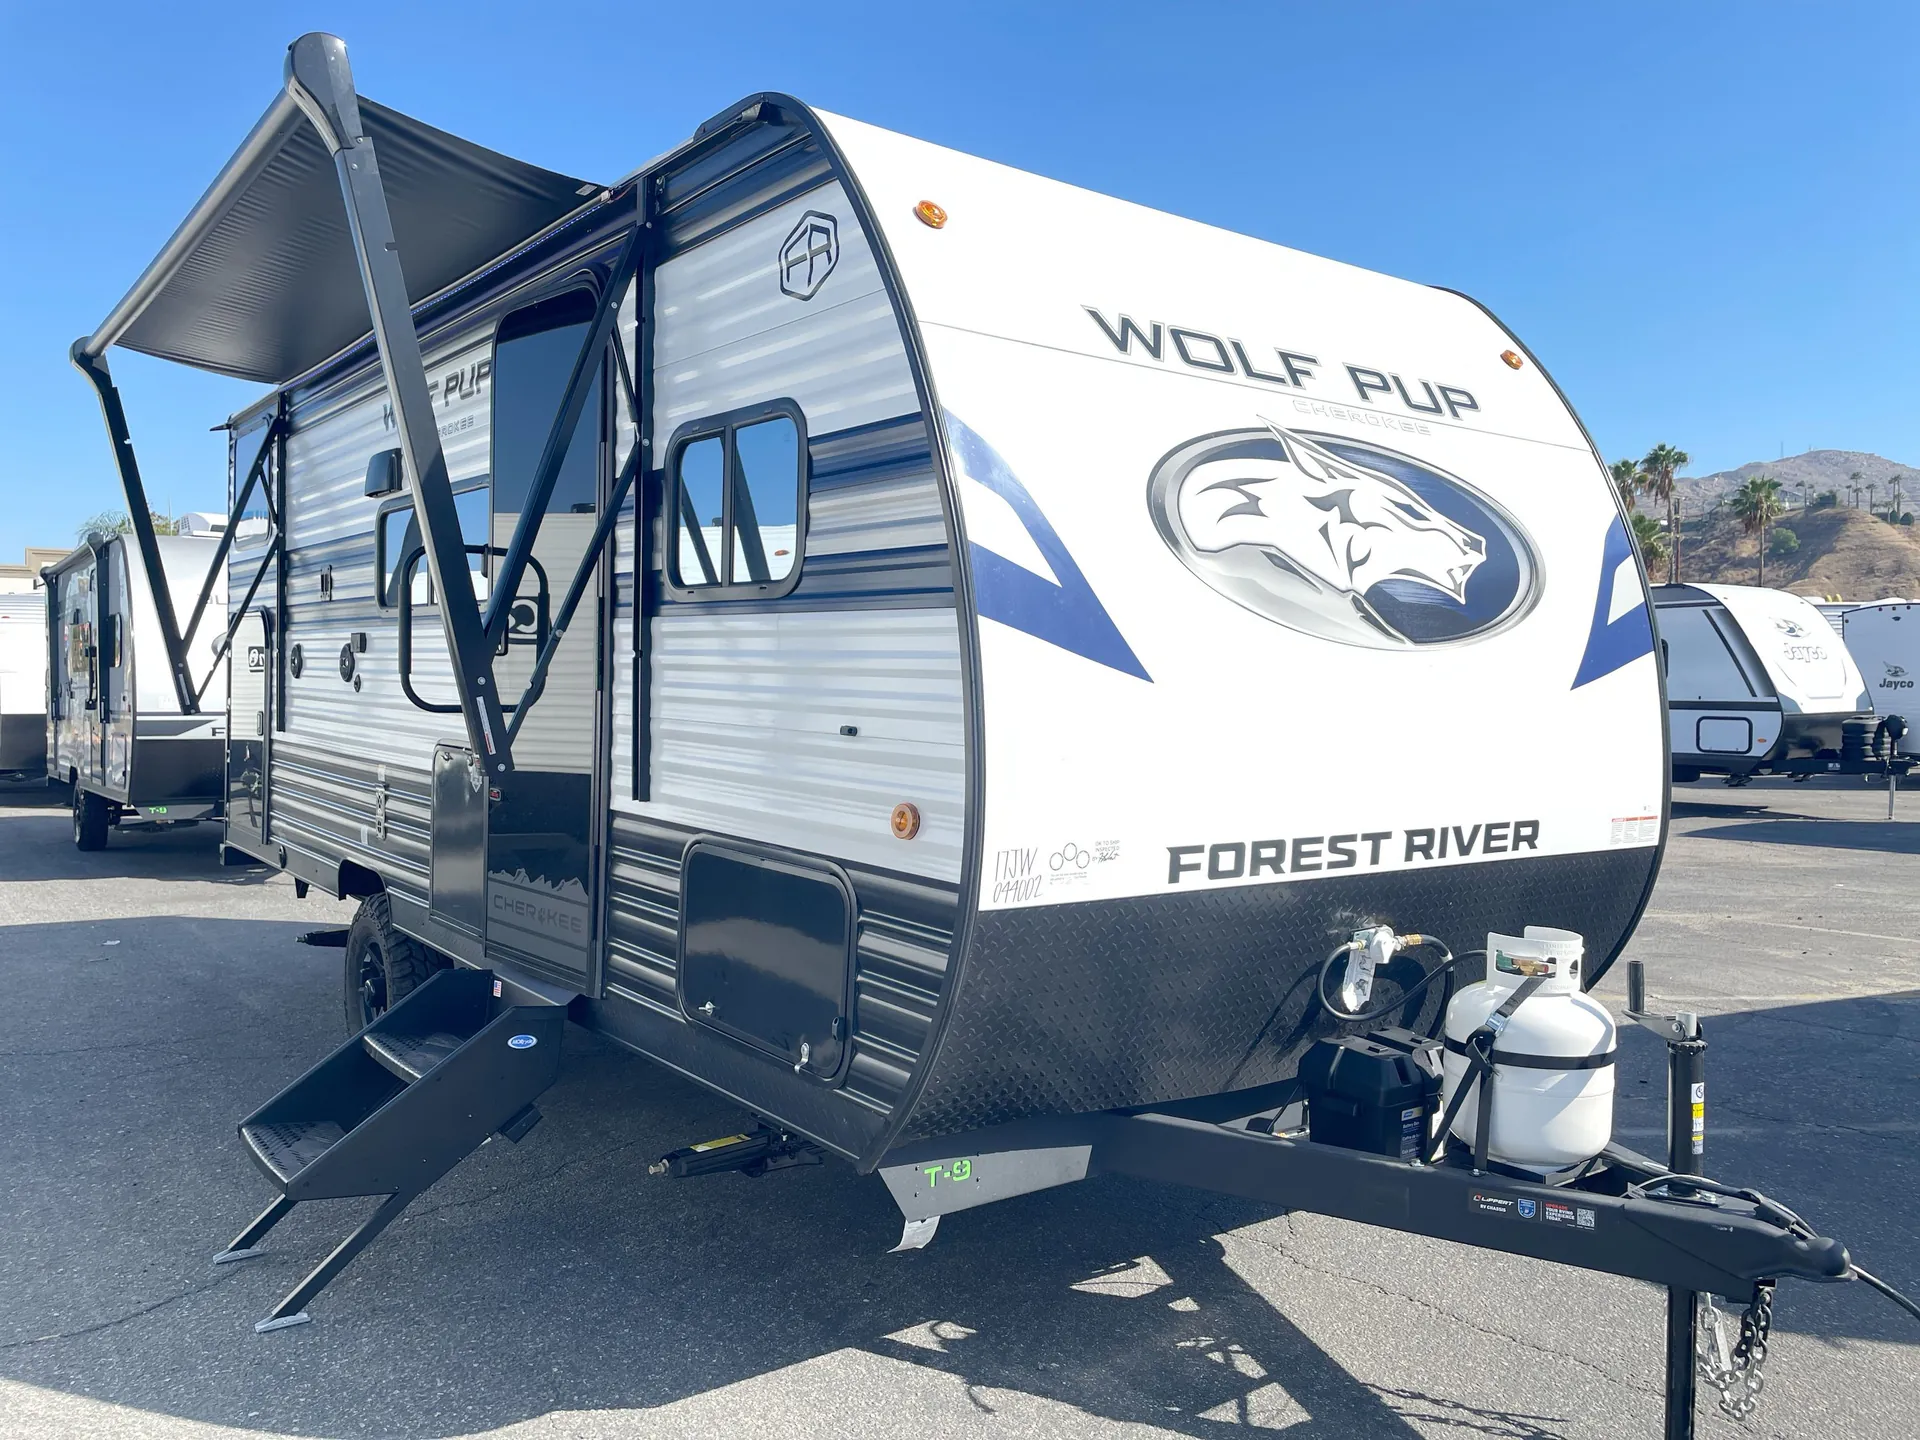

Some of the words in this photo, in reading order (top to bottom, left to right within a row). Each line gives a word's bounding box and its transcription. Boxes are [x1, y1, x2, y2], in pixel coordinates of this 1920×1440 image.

[1080, 304, 1322, 389] WOLF
[1343, 363, 1481, 420] PUP
[1292, 399, 1432, 436] CHEROKEE
[1783, 642, 1828, 663] Jayco
[1879, 678, 1914, 690] Jayco
[1166, 831, 1393, 884] FOREST
[1403, 819, 1540, 862] RIVER
[924, 1159, 972, 1188] T-9
